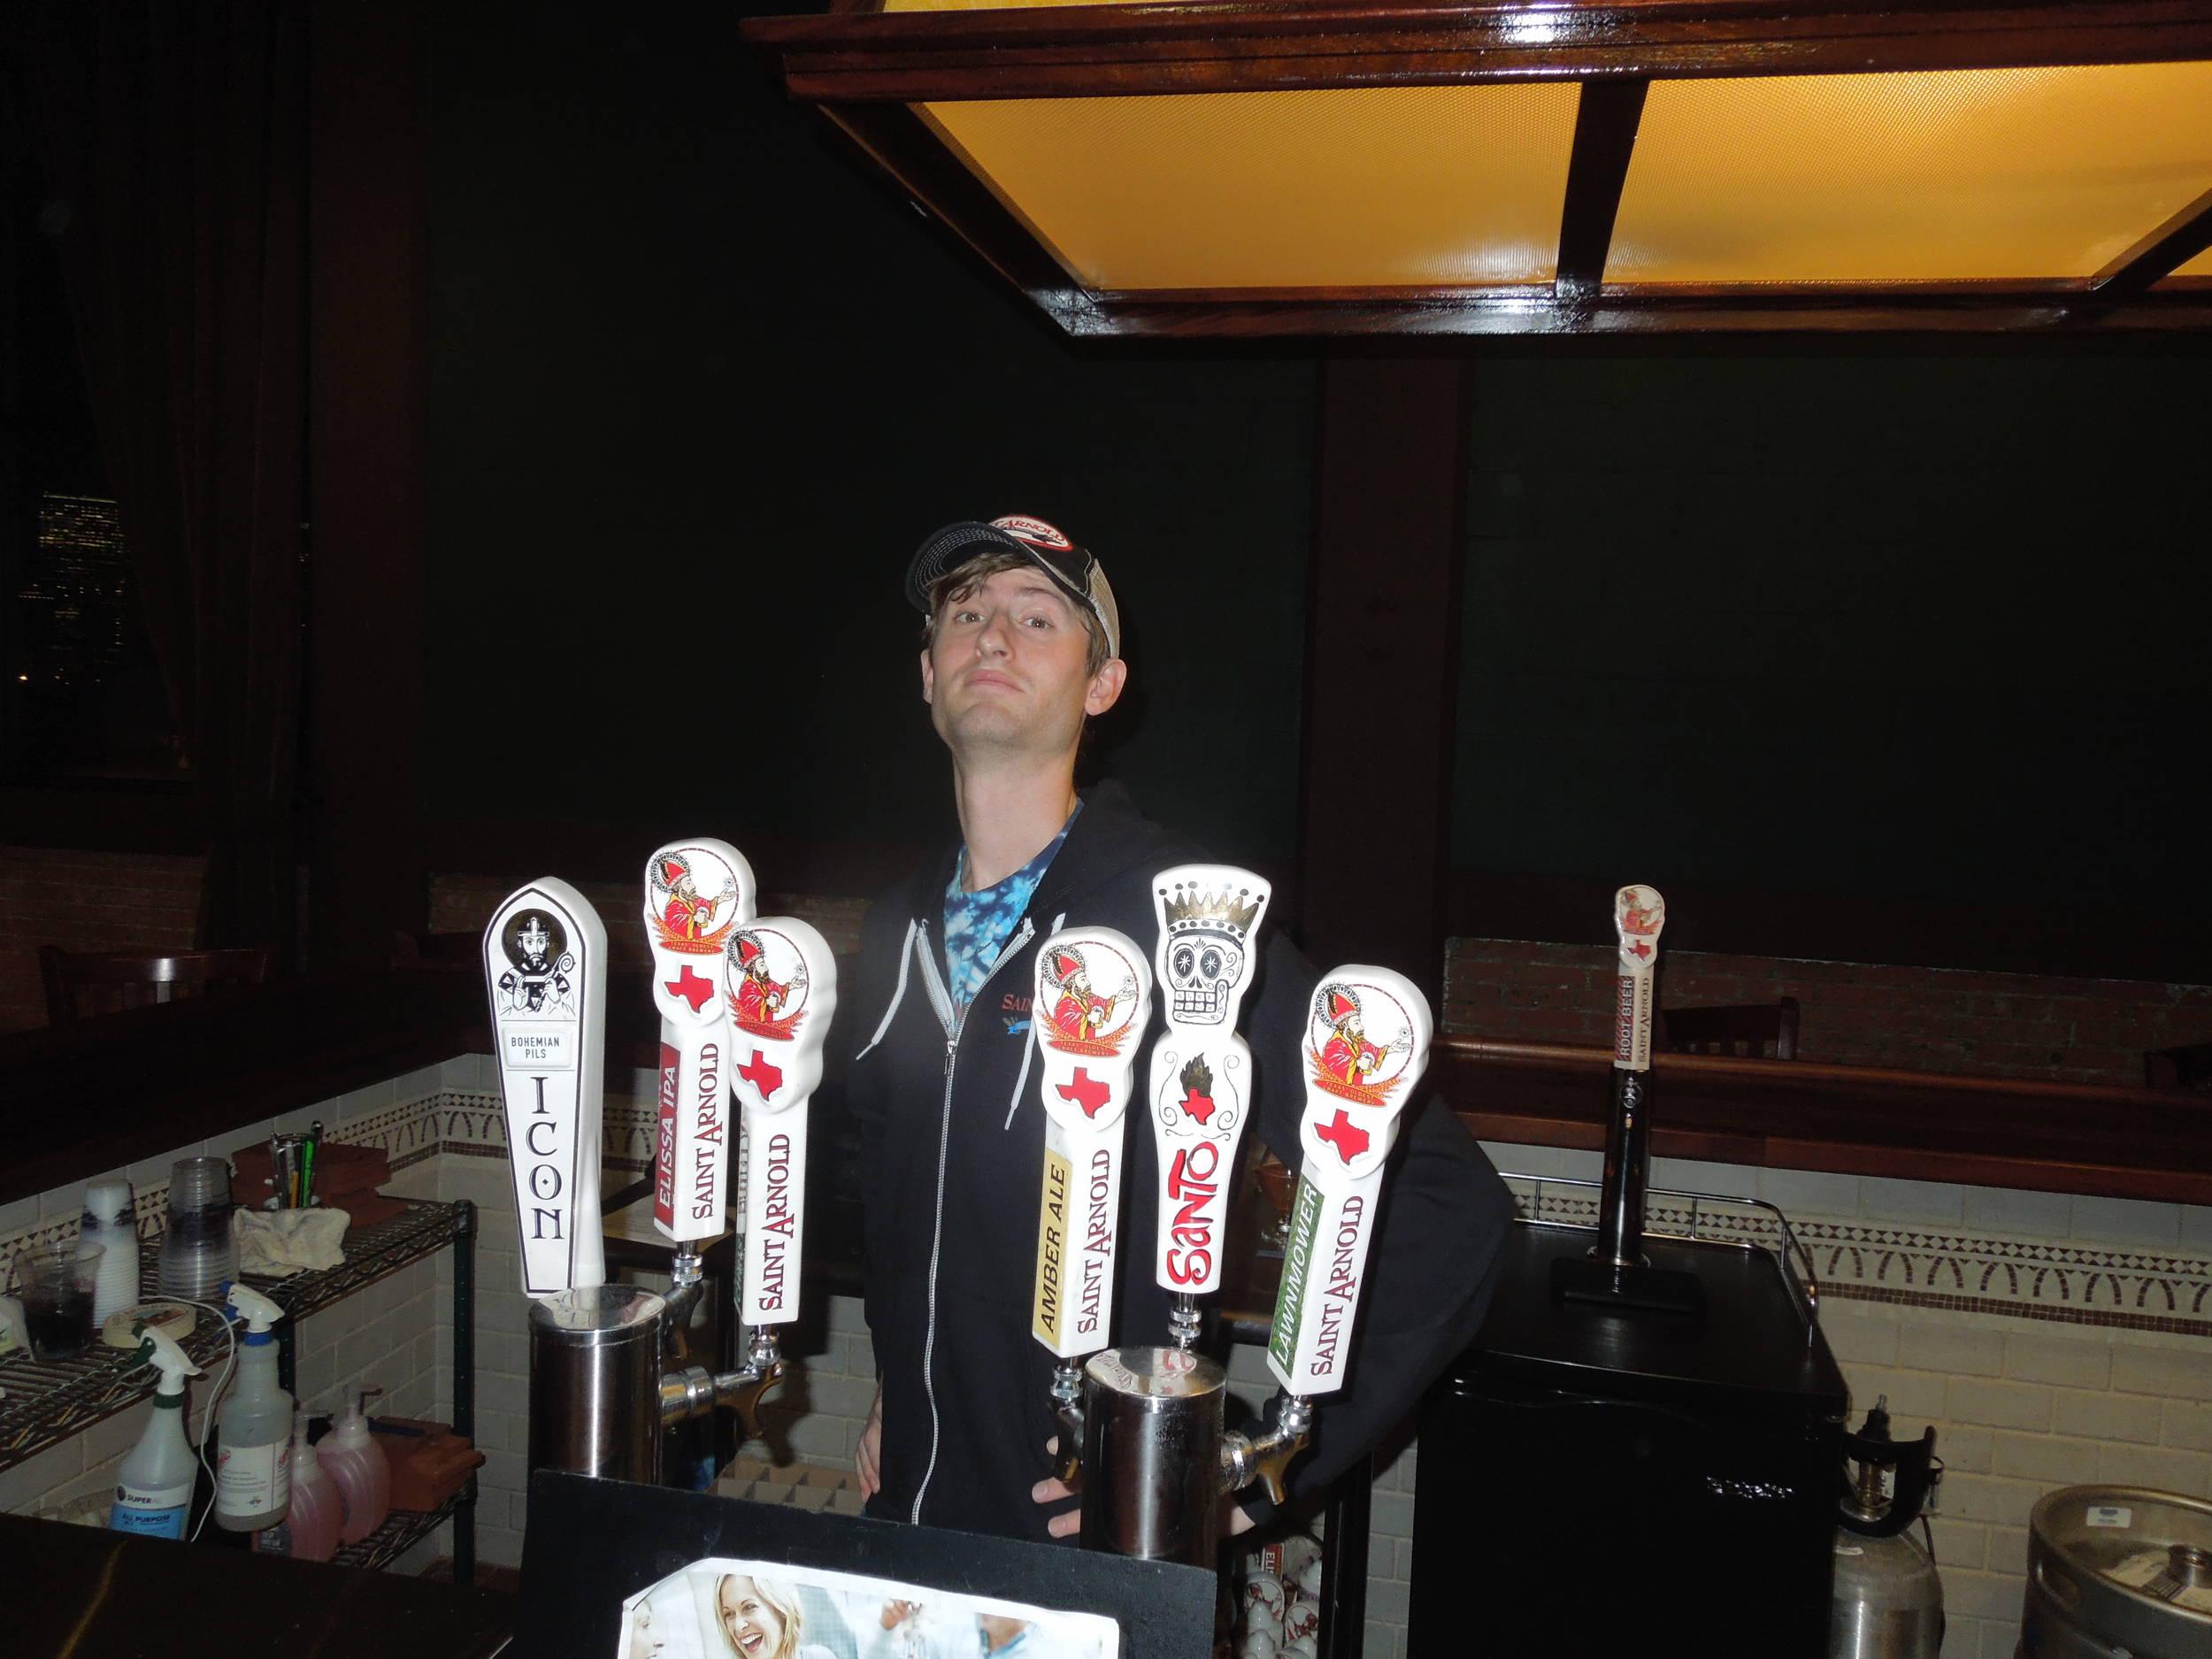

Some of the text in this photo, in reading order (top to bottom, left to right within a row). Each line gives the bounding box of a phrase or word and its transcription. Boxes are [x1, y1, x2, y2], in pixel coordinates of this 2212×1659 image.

[511, 1036, 560, 1048] BOHEMIAN
[525, 1048, 547, 1059] PILS
[1001, 994, 1033, 1013] SAIN
[1621, 979, 1633, 1056] ROOT BEER
[1638, 978, 1650, 1062] SAINT ARNOLD
[526, 1076, 565, 1240] ICON
[659, 1066, 676, 1210] ELISSA IPA
[692, 1042, 723, 1219] SAINT ARNOLD
[758, 1133, 795, 1310] SAINT ARNOLD
[1041, 1164, 1066, 1334] AMBER ALE
[1078, 1148, 1112, 1333] SAINT ARNOLD
[1276, 1182, 1318, 1367] LAWNMOWER
[1310, 1195, 1364, 1377] SAINT ARNOLD
[1265, 1552, 1275, 1573] ELI
